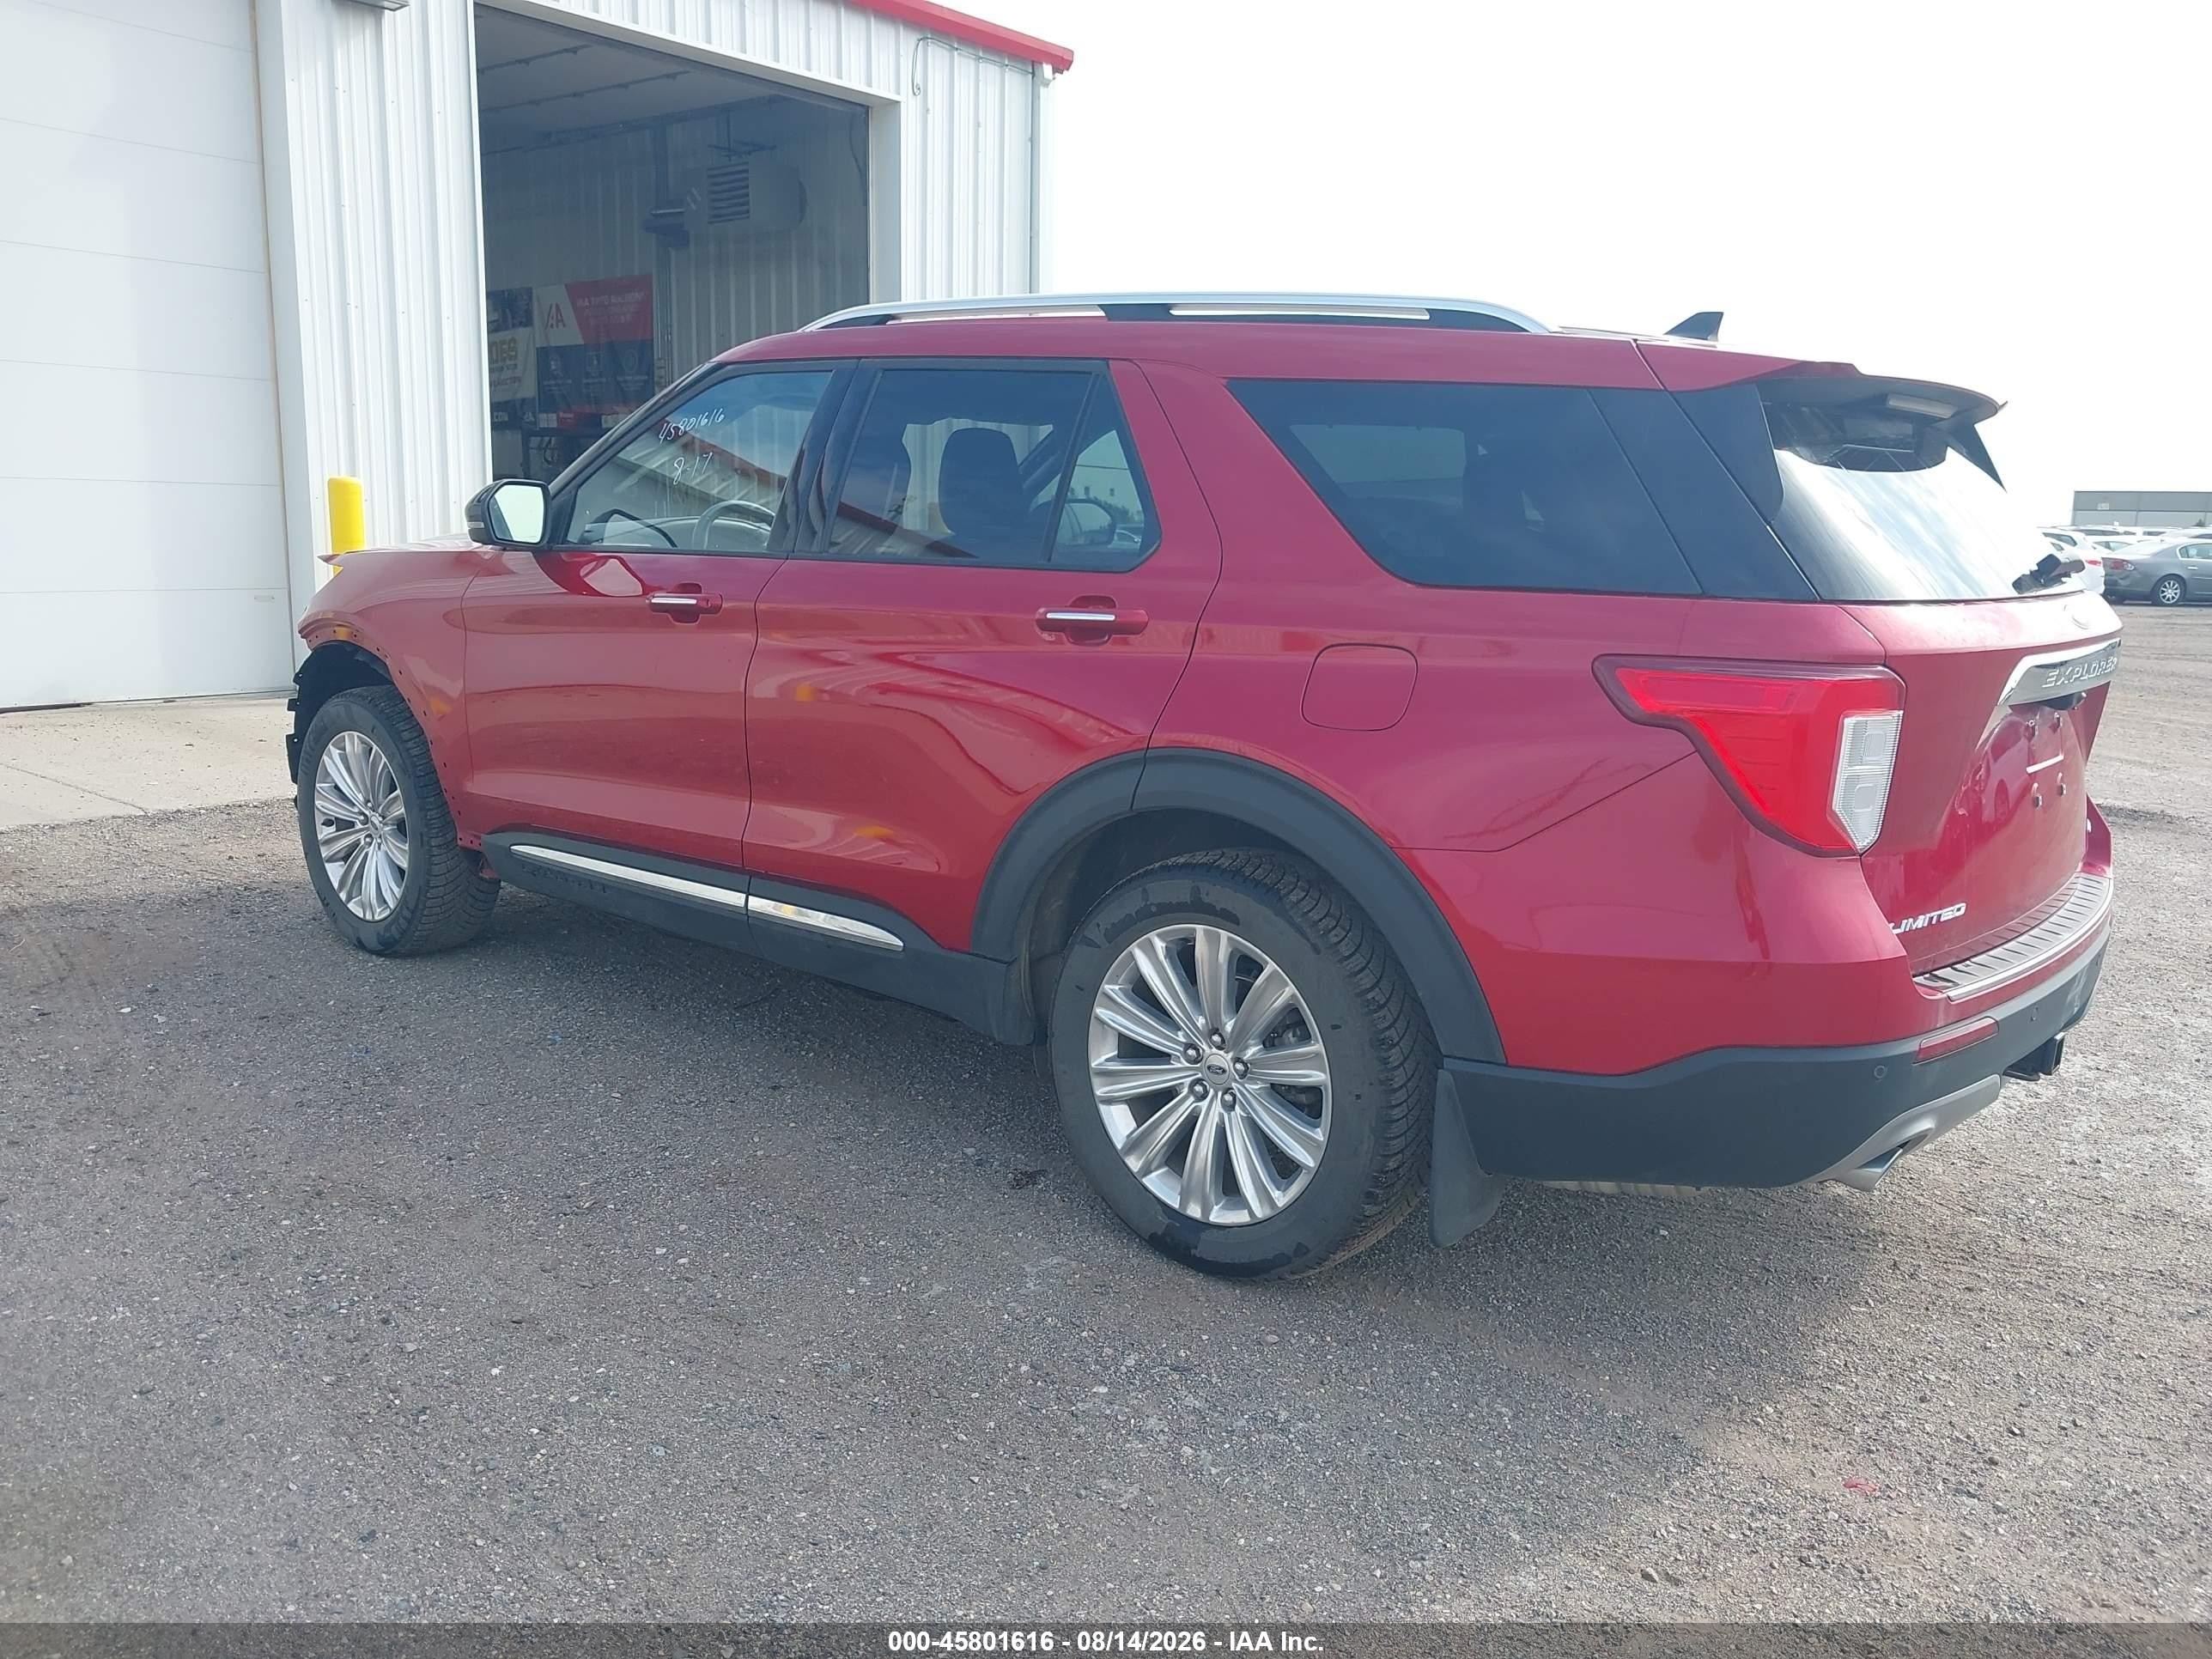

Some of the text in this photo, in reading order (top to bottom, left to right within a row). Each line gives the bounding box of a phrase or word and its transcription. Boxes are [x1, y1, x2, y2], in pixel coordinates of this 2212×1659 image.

[659, 408, 725, 444] 45801616
[673, 452, 713, 485] 8-17
[2042, 655, 2118, 688] EXPLORER
[1887, 902, 1967, 934] LIMITED
